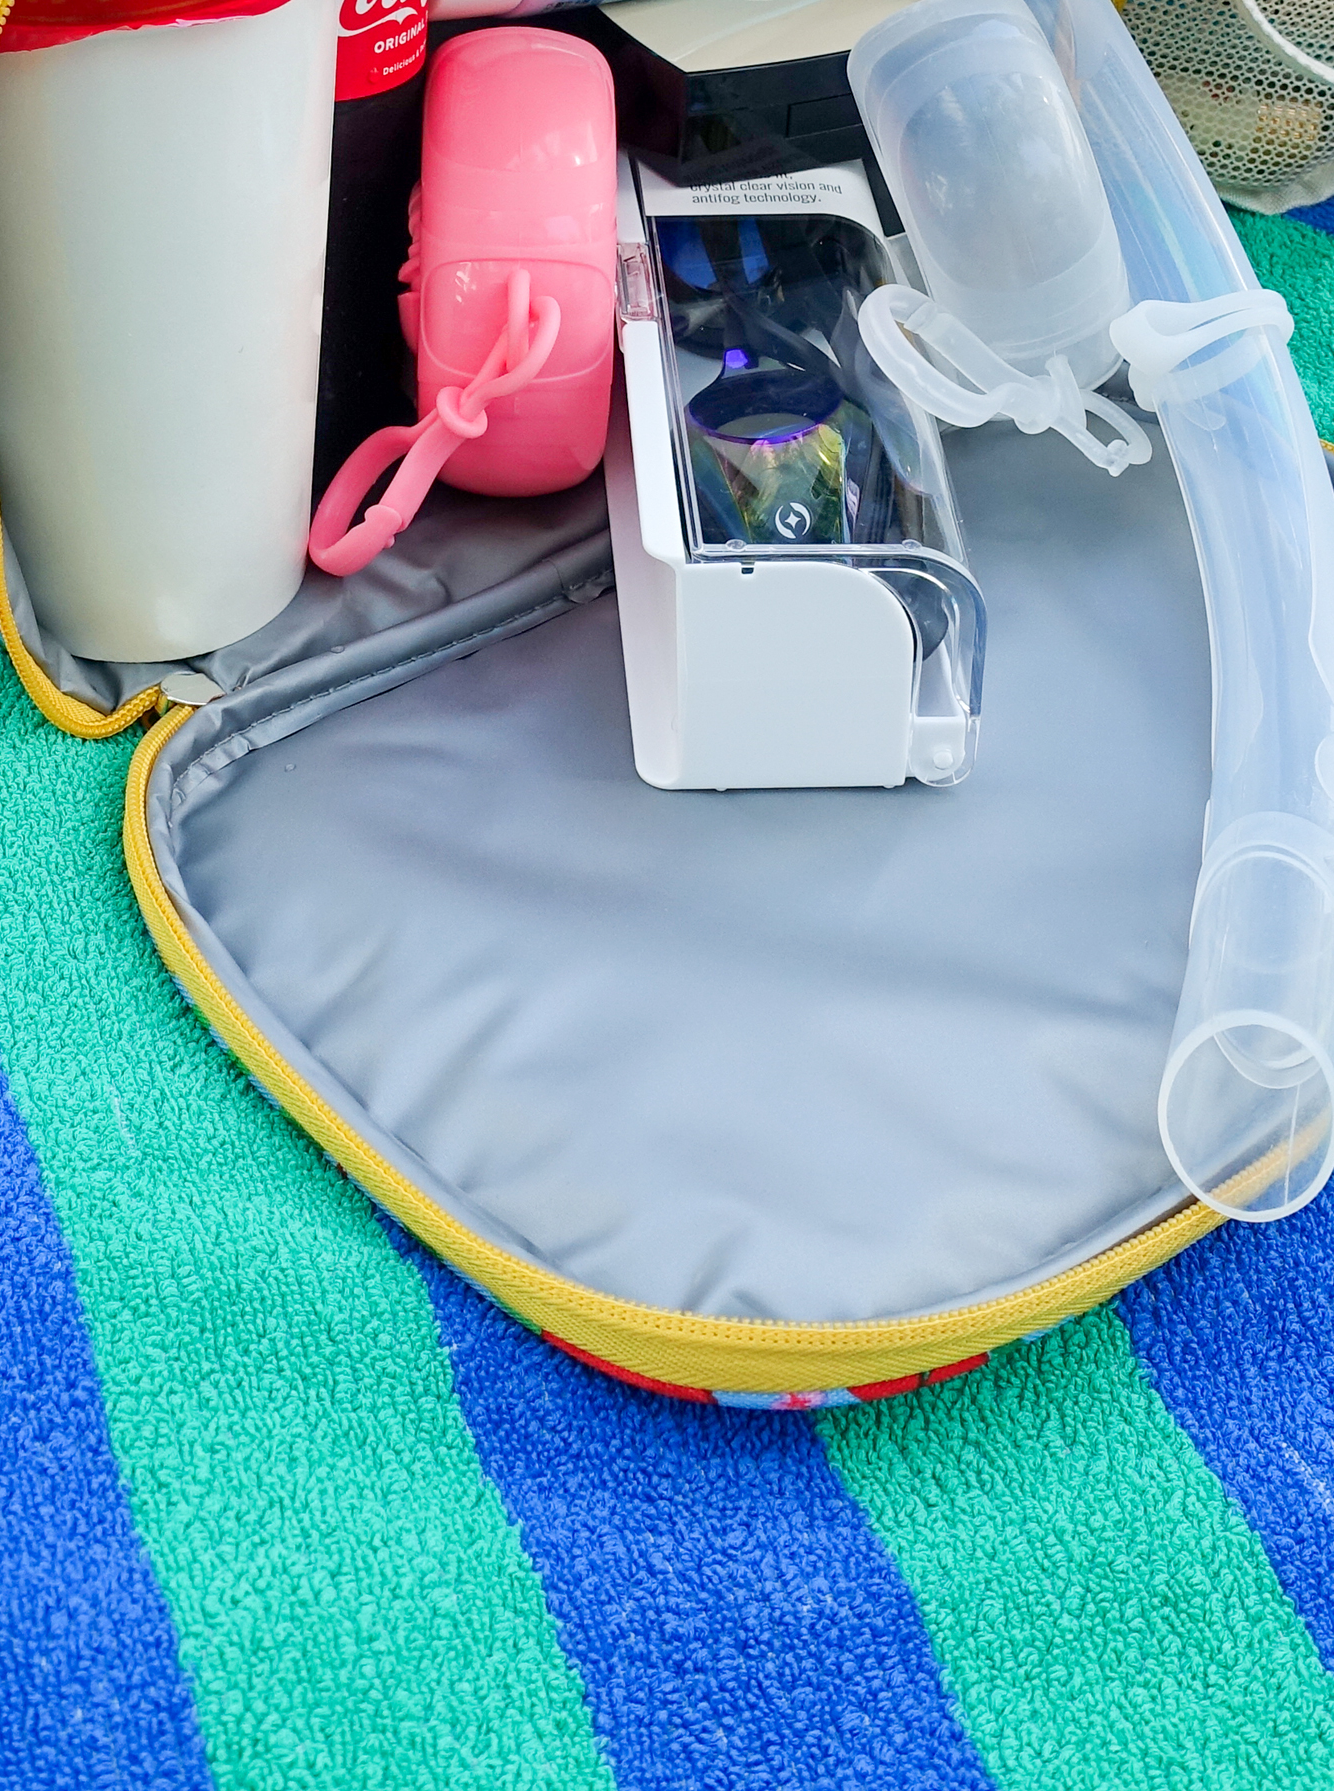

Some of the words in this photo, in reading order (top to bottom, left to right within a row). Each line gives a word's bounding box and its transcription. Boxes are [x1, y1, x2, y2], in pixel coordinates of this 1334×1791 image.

[374, 18, 425, 54] ORIGINAL
[383, 54, 415, 75] Delicious
[690, 180, 736, 193] crystal
[739, 181, 772, 192] clear
[776, 181, 815, 191] vision
[819, 183, 842, 194] and
[692, 193, 740, 205] antifog
[744, 192, 822, 205] technology.
